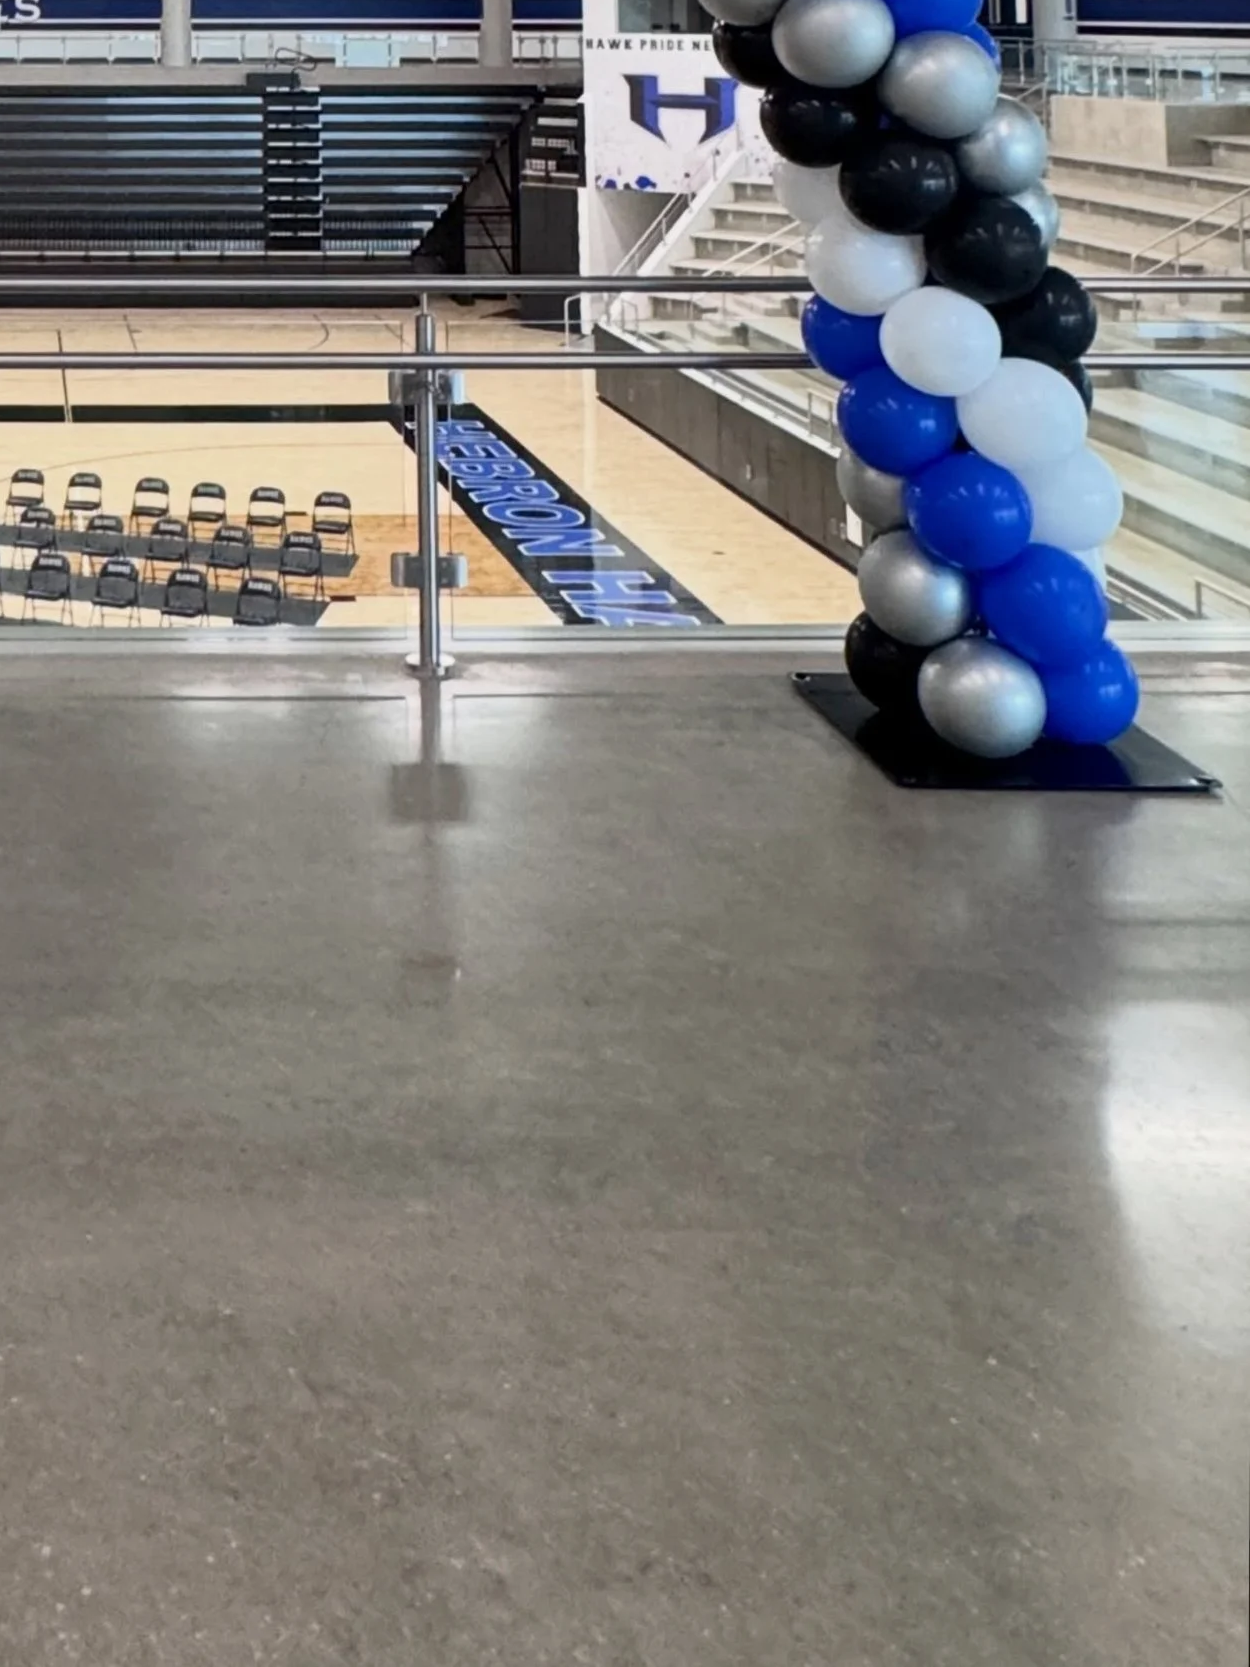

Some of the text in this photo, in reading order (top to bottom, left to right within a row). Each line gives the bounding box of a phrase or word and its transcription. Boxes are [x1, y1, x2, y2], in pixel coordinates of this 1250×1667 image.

[585, 38, 632, 50] HAWK
[639, 39, 685, 51] PRIDE
[405, 418, 625, 558] HEBRON
